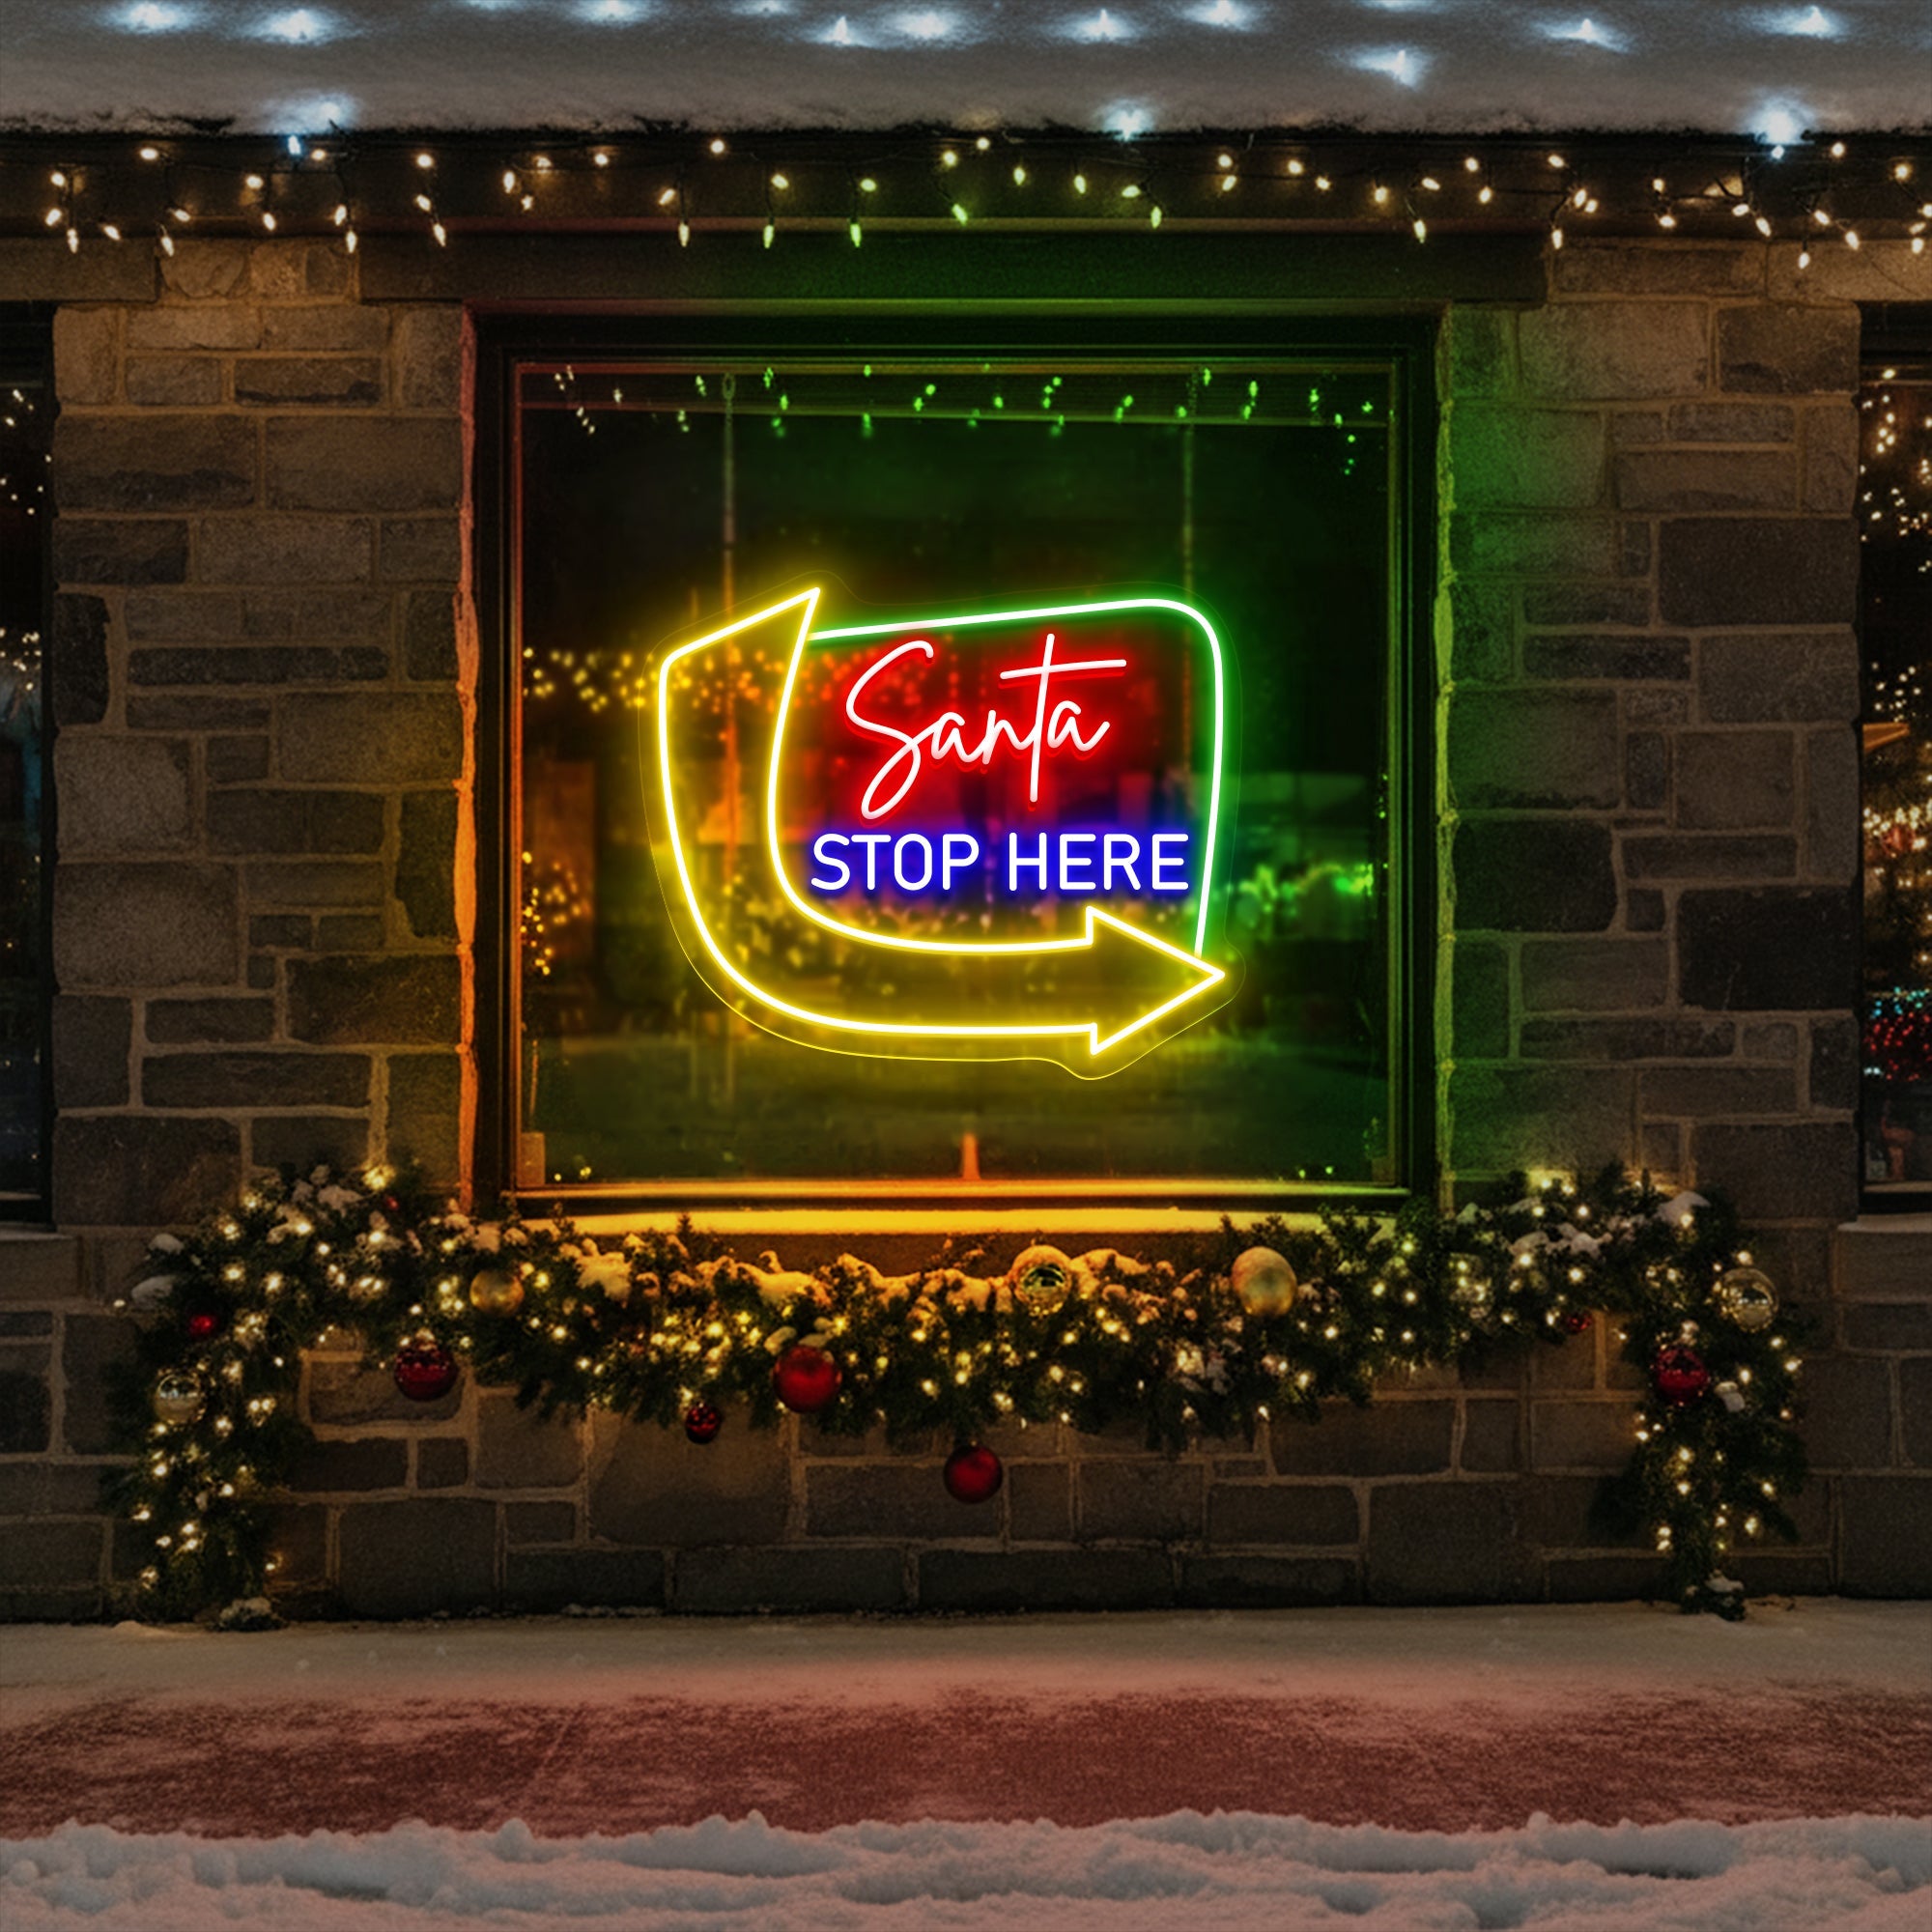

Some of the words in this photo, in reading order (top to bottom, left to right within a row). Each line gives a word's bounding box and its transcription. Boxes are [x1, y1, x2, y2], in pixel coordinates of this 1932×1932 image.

[845, 634, 1127, 820] Santa
[810, 833, 980, 892] STOP
[1009, 832, 1189, 892] HERE
